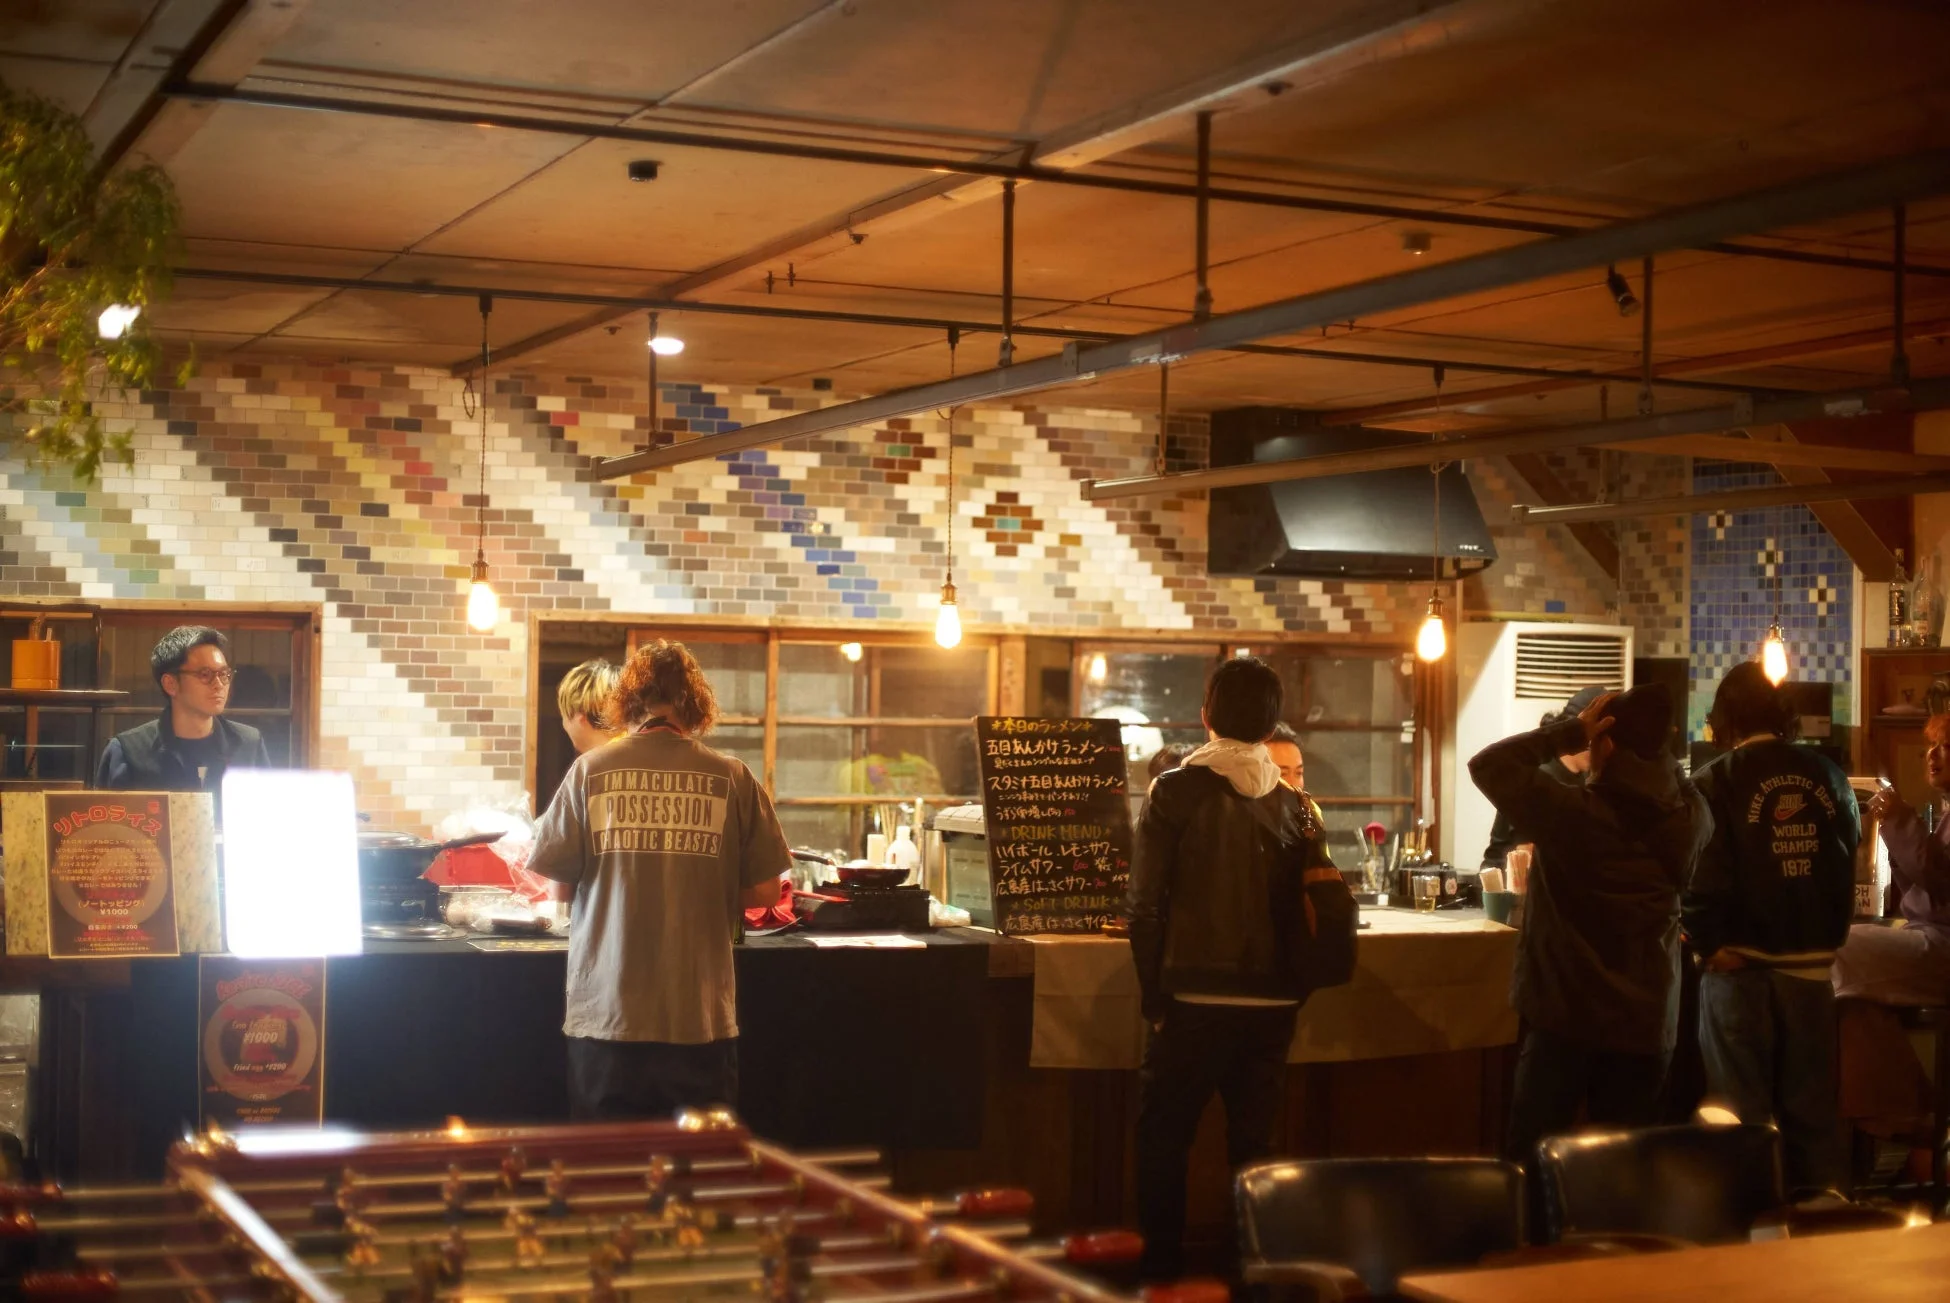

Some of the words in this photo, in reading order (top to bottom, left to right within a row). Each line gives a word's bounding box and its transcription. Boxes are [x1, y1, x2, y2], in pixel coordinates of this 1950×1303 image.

[986, 739, 1105, 756] 五目あんかけラーメン
[604, 771, 714, 794] IMMACULATE
[988, 775, 1124, 790] スタミナ五目あんかけラーメン
[1748, 793, 1765, 824] NIKE
[1760, 774, 1814, 794] ATHLETIC
[606, 794, 712, 828] POSSESSION
[53, 805, 162, 837] リトロライス
[1012, 824, 1056, 840] DRINK
[1060, 824, 1101, 839] MENU
[1772, 823, 1817, 837] WORLD
[600, 829, 658, 850] CHAOTIC
[664, 830, 718, 854] BEASTS
[1772, 840, 1819, 854] CHAMPS
[1000, 860, 1064, 876] ライムサワー
[1782, 860, 1812, 877] 1972
[1064, 896, 1109, 910] DRINK
